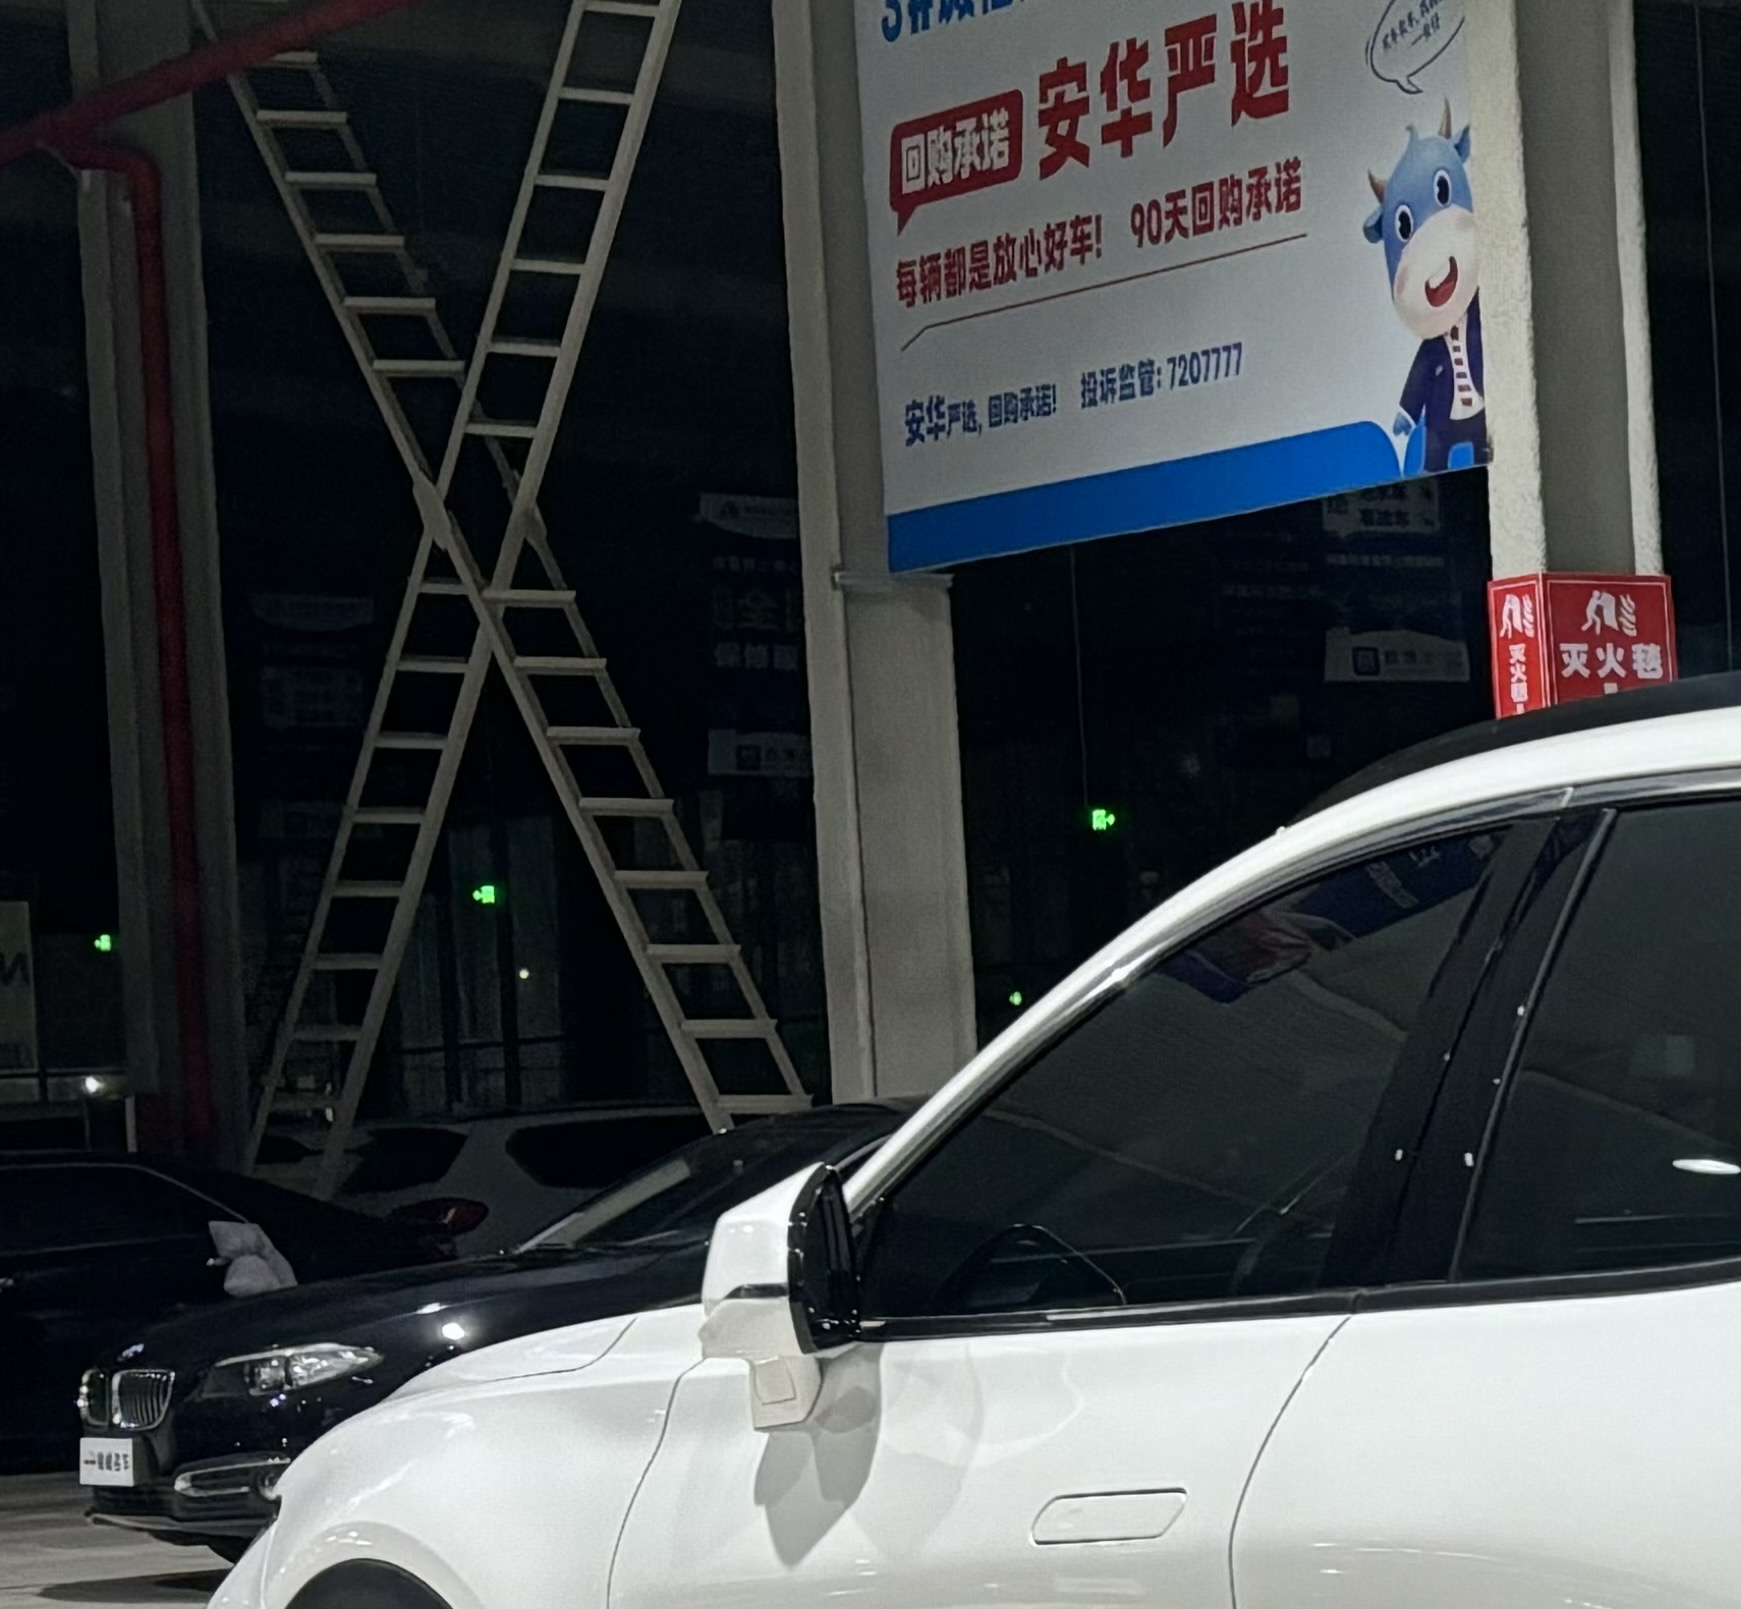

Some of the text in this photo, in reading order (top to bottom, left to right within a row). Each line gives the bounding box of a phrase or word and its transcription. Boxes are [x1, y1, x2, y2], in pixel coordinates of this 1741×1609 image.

[901, 1, 1290, 196] 回购承诺 安华严选
[1130, 156, 1302, 249] 90天回购承诺
